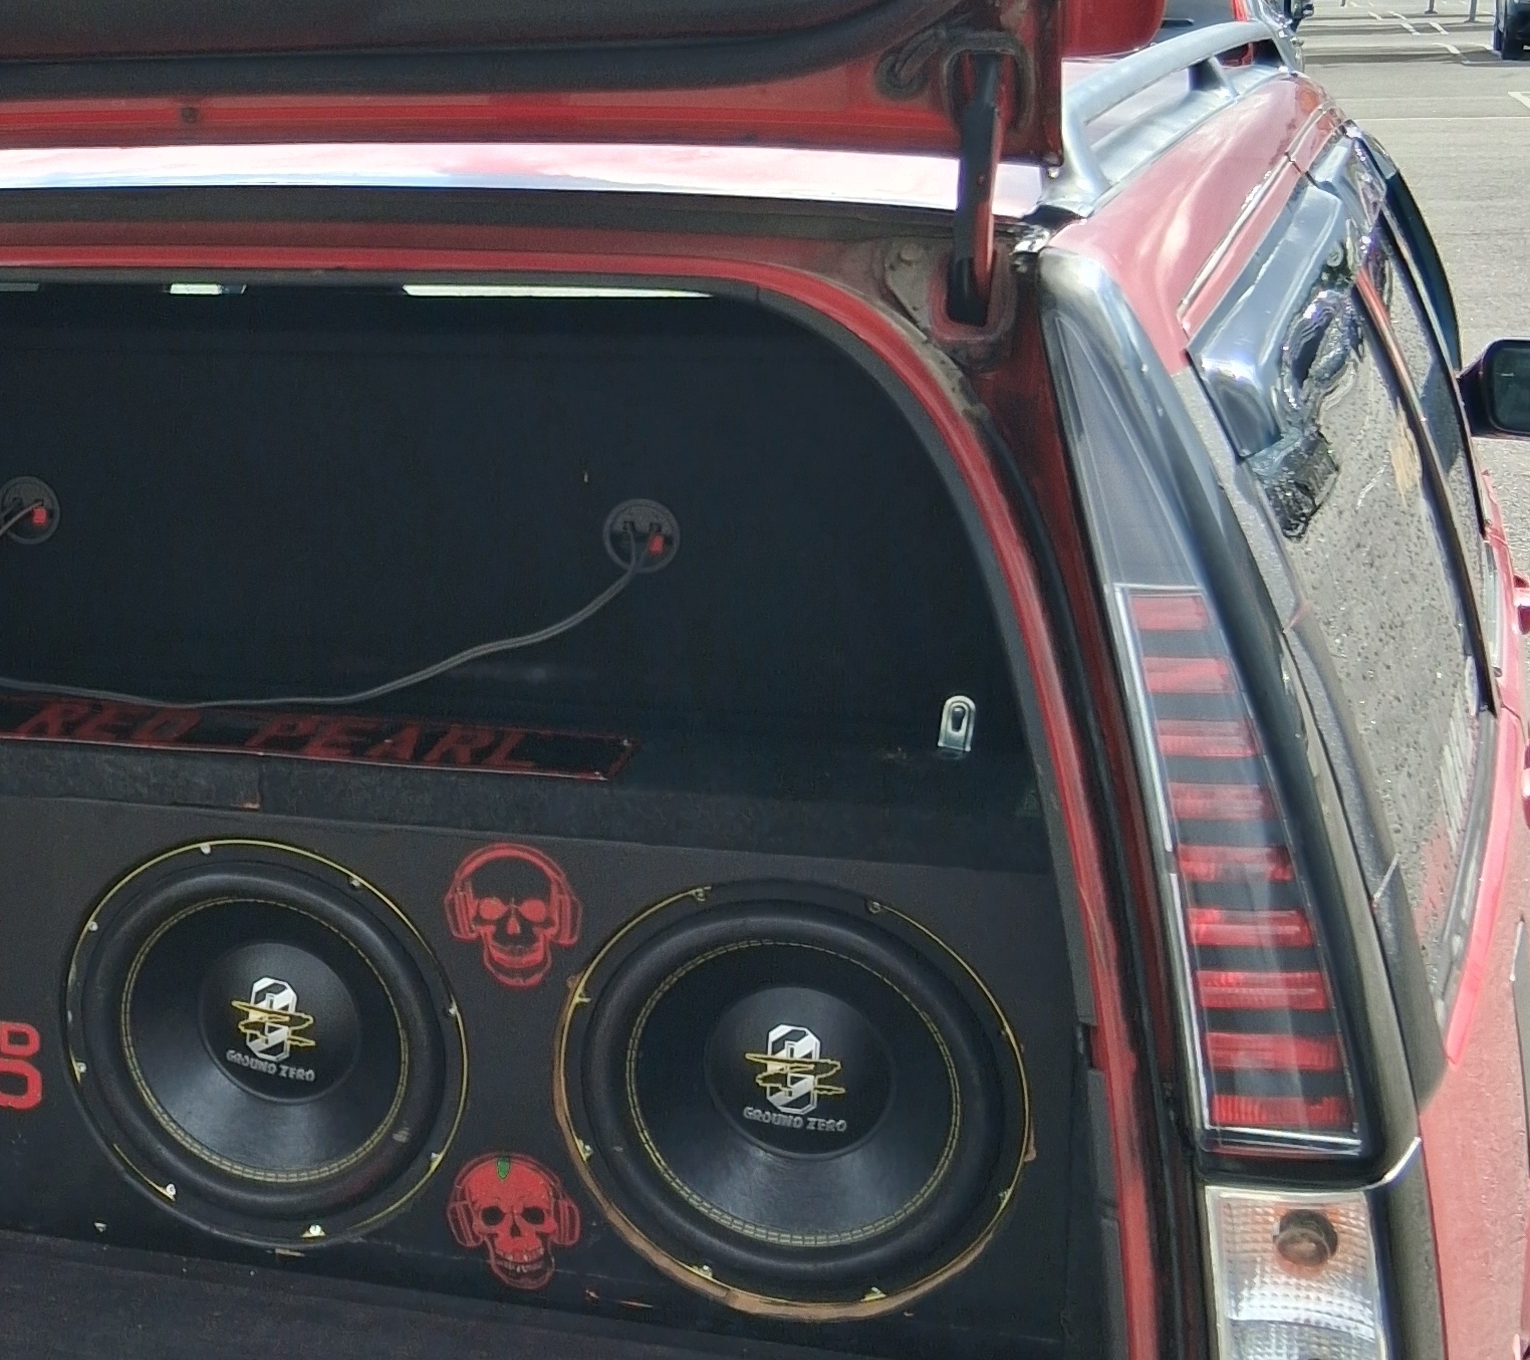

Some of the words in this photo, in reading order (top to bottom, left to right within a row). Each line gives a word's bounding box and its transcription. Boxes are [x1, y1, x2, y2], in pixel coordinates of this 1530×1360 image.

[16, 701, 201, 744] RED
[246, 713, 543, 771] PEARL
[226, 1049, 277, 1074] GROUND
[278, 1064, 316, 1082] ZERO
[743, 1106, 804, 1128] GROUND
[806, 1117, 847, 1132] ZERO
